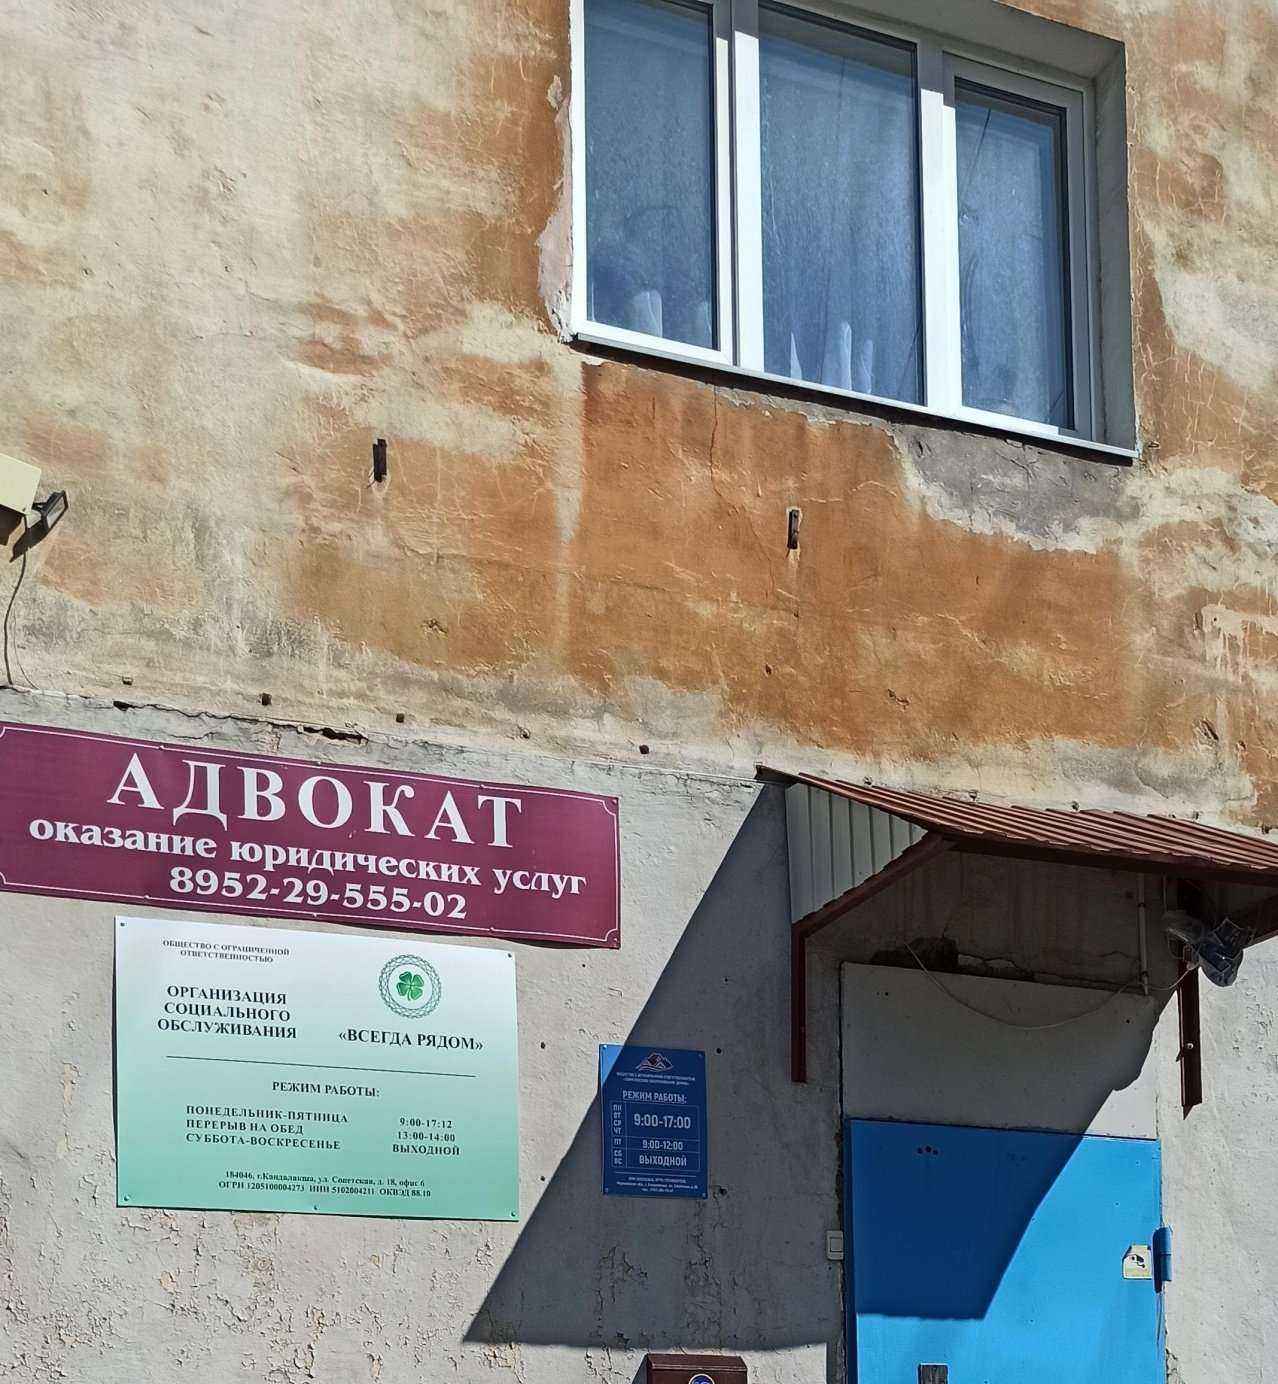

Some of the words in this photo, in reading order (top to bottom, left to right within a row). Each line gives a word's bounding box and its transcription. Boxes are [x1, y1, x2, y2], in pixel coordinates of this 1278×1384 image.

[107, 752, 523, 849] АДВОКАТ
[29, 818, 217, 859] оказание
[231, 839, 480, 887] юридических
[492, 867, 587, 899] услуг
[169, 866, 468, 920] 8952-29-555-02
[163, 939, 212, 950] ОБЩЕСТВО
[213, 943, 220, 951] С
[221, 943, 290, 956] ОГРАНИЧЕННОЙ
[180, 949, 274, 963] ОТВЕТСТВЕННОСТЬЮ
[167, 985, 287, 1005] ОРГАНИЗАЦИЯ
[164, 1002, 291, 1022] СОЦИАЛЬНОГО
[157, 1018, 297, 1039] ОБСЛУЖИВАНИЯ
[339, 1028, 412, 1046] «ВСЕГДА
[417, 1033, 484, 1051] РЯДОМ»
[272, 1081, 321, 1094] РЕЖИМ
[325, 1084, 381, 1097] РАБОТЫ:
[622, 1090, 652, 1101] РЕЖИМ
[654, 1092, 687, 1104] РАБОТЫ:
[186, 1105, 349, 1124] ПОНЕДЕЛЬНИК-ПЯТНИЦА
[399, 1116, 453, 1129] 9:00-17:12
[633, 1113, 691, 1129] 9:00-17:00
[186, 1119, 247, 1131] ПЕРЕРЫВ
[250, 1123, 267, 1132] НА
[270, 1123, 304, 1136] ОБЕД
[397, 1131, 456, 1142] 13:00-14:00
[186, 1133, 341, 1150] СУББОТА-ВОСКРЕСЕНЬЕ
[392, 1143, 460, 1156] ВЫХОДНОЙ
[642, 1139, 684, 1151] 9:00-12:00
[639, 1154, 688, 1167] ВЫХОДНОЙ
